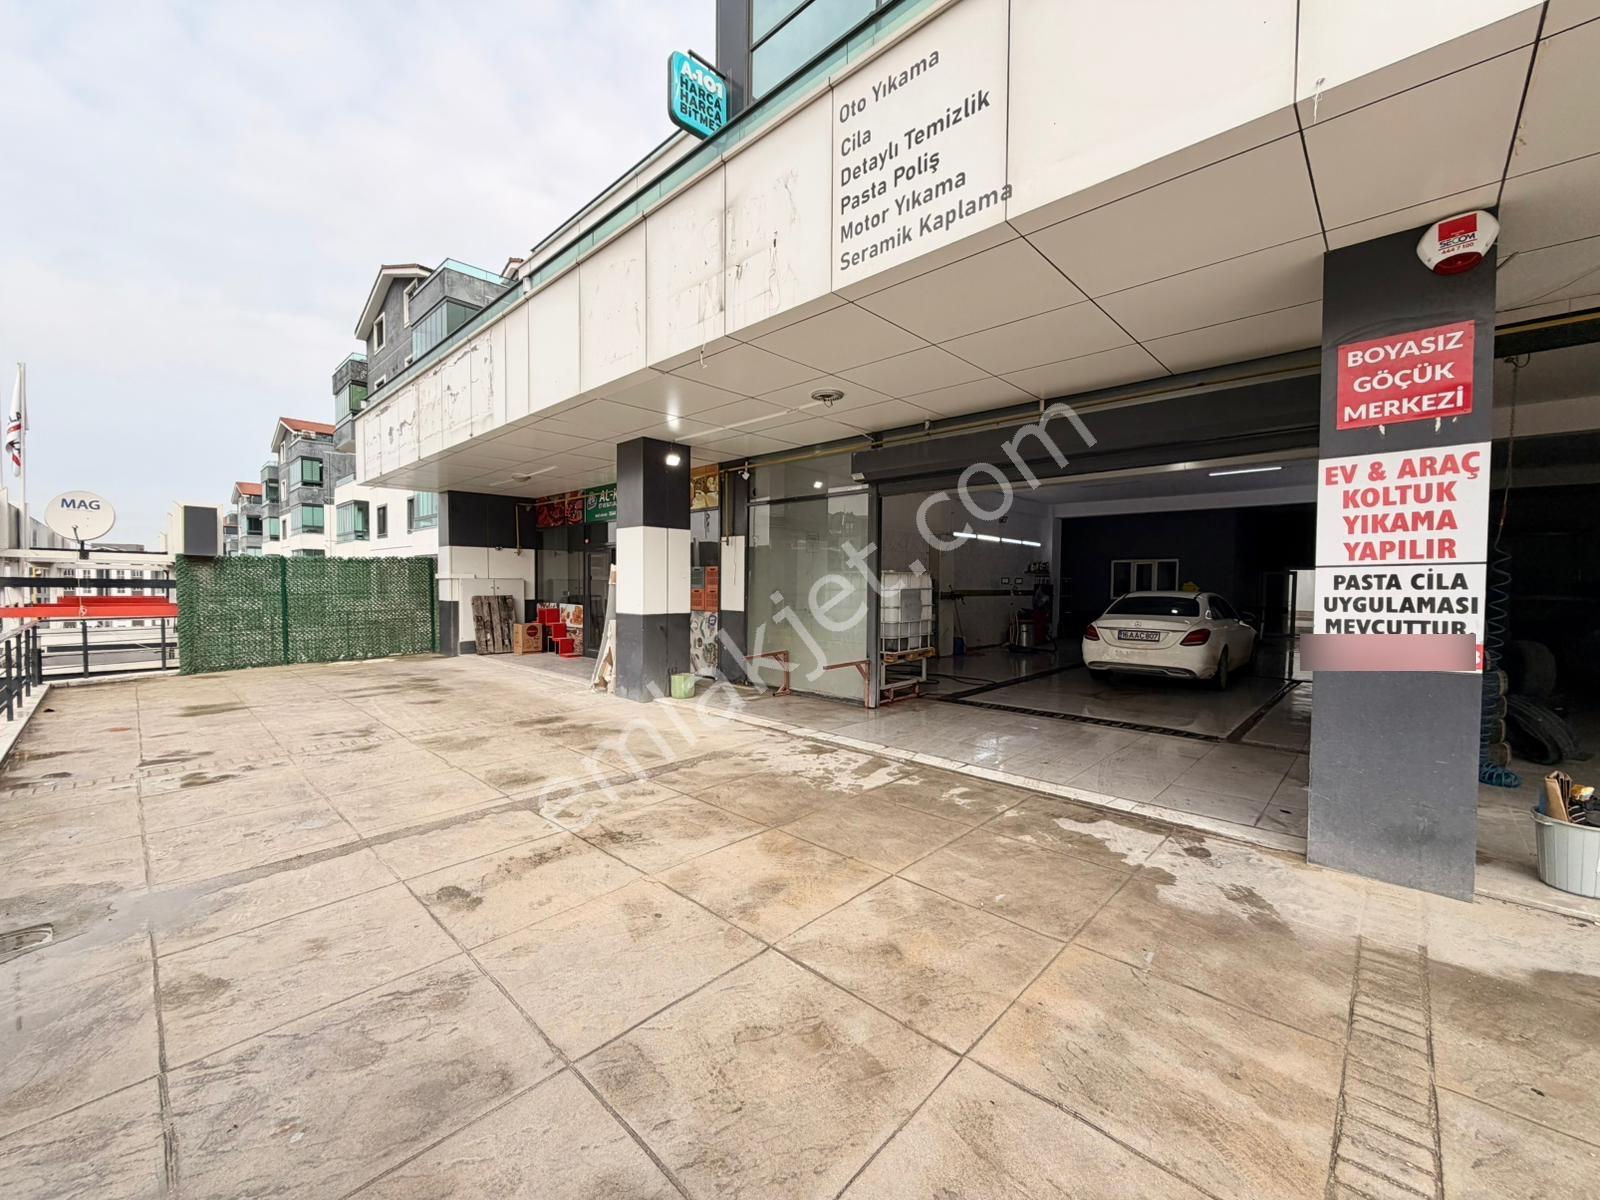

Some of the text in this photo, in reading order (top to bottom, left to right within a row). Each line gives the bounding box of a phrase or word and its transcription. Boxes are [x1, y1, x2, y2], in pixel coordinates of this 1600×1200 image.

[680, 73, 722, 112] HARCA
[839, 50, 940, 124] Oto Yıkama
[680, 88, 722, 124] HARCA
[840, 88, 991, 187] Detaylı Temizlik
[840, 128, 872, 157] Cila
[840, 150, 940, 215] Pasta Poliş
[840, 171, 966, 244] Motor Yıkama
[840, 183, 1013, 272] Seramik Kaplama
[1347, 330, 1465, 368] BOYASIZ
[1353, 362, 1455, 393] GÖÇÜK
[1343, 385, 1464, 422] MERKEZİ
[1325, 451, 1481, 486] EV & ARAÇ
[60, 498, 101, 511] MAG
[1342, 481, 1458, 509] KOLTUK
[1342, 509, 1458, 535] YIKAMA
[1343, 538, 1457, 561] YAPILIR
[1333, 568, 1469, 591] PASTA CİLA
[1323, 596, 1479, 615] UYGULAMASI
